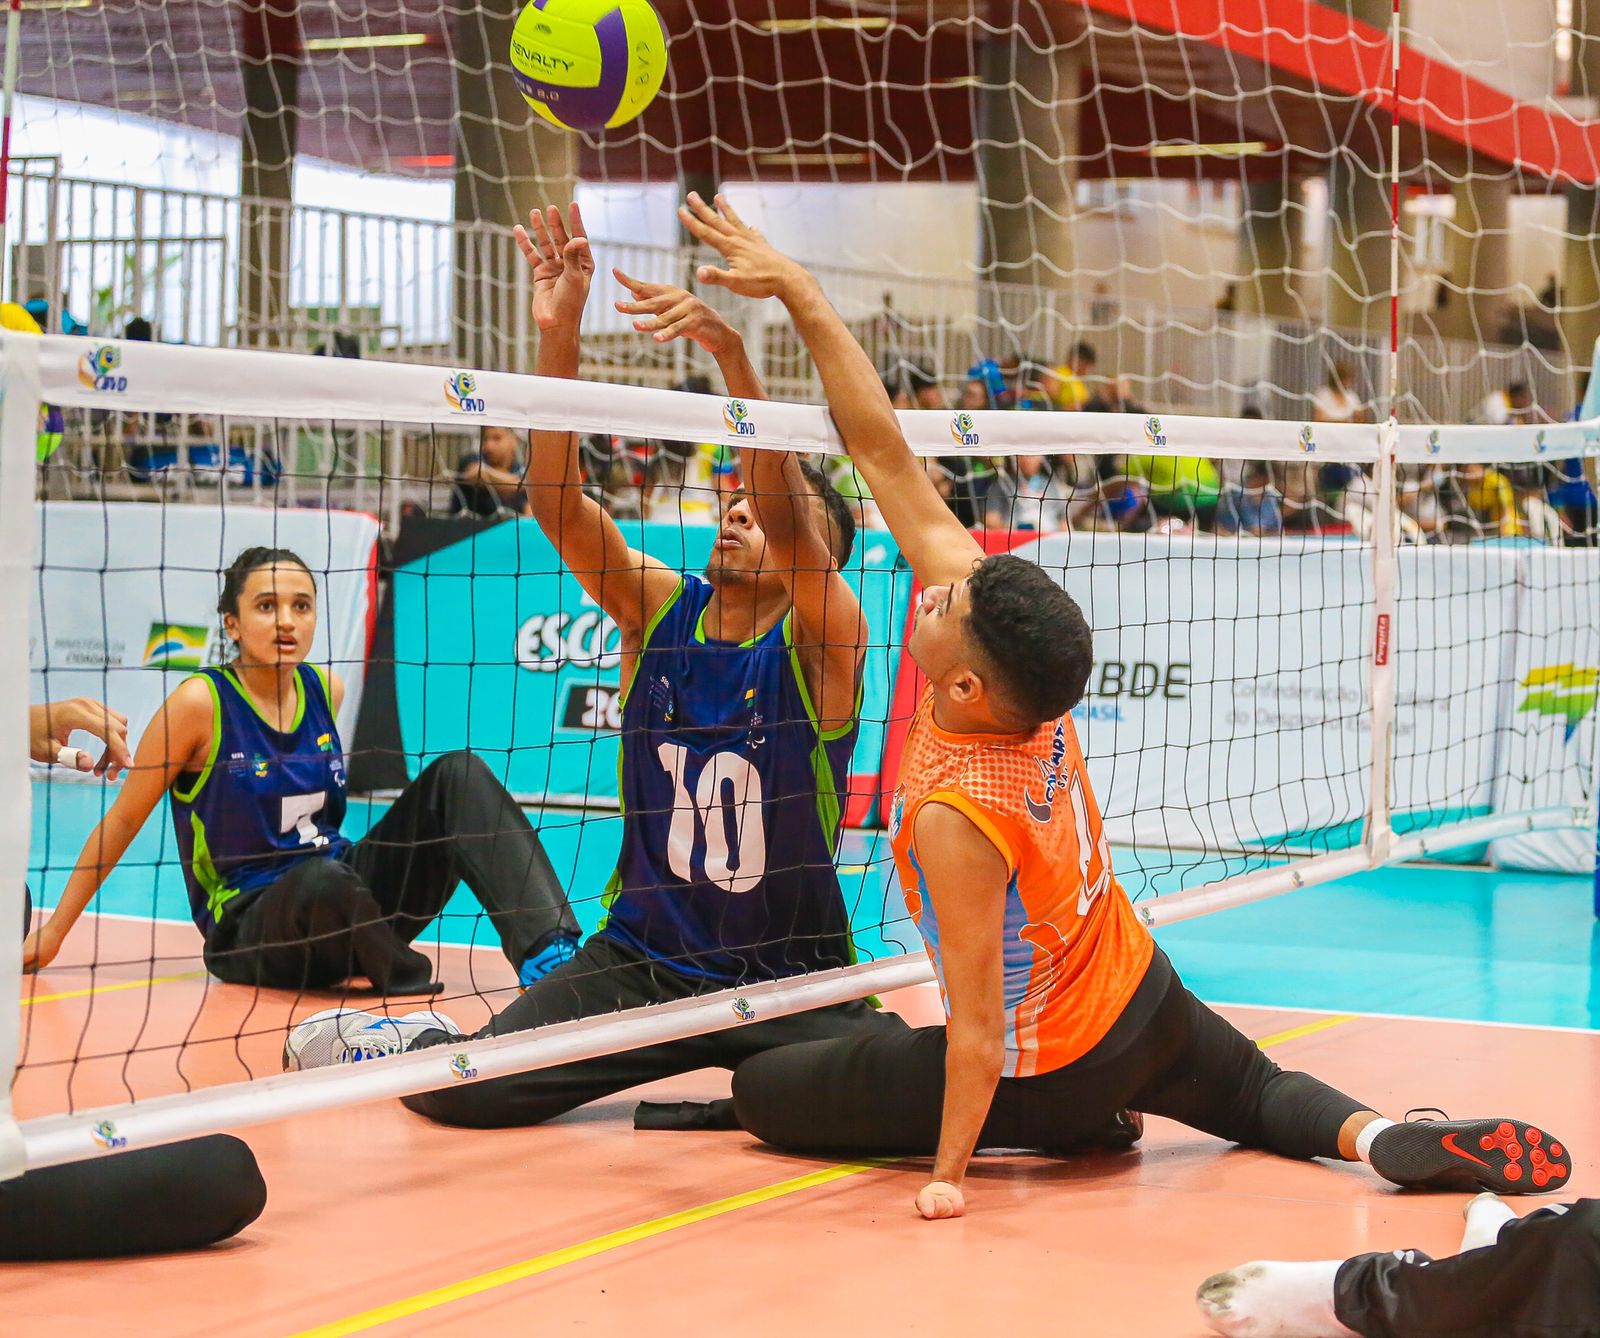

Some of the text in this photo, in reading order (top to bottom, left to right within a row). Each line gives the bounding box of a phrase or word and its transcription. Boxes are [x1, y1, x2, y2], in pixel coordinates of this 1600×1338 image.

[460, 397, 485, 412] CBVD
[735, 421, 756, 435] CBVD
[961, 433, 979, 445] CBVD
[1092, 661, 1190, 698] BDE
[657, 742, 766, 893] 10
